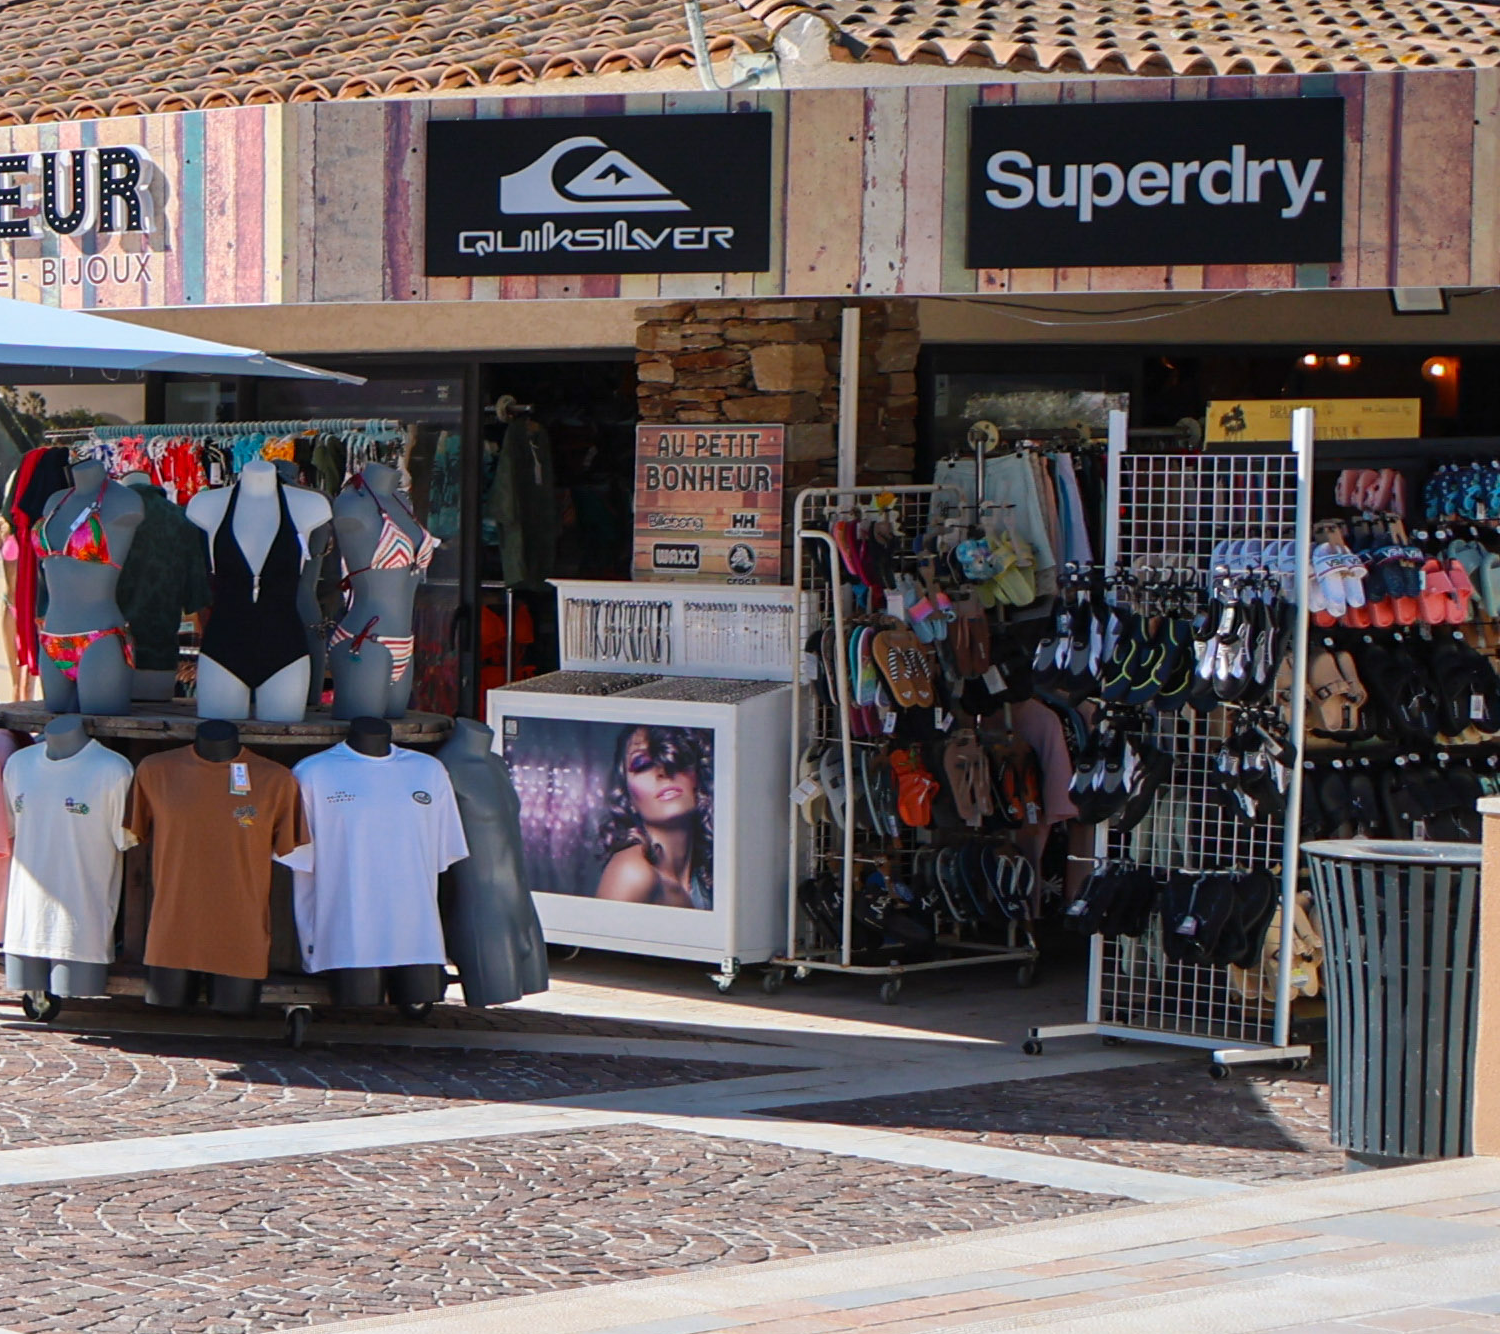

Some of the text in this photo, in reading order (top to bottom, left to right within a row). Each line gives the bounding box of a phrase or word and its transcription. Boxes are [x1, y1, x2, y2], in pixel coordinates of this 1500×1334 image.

[985, 144, 1326, 222] Superdry.
[458, 219, 735, 257] QUIKSILVER
[42, 253, 153, 286] BIJOUX
[658, 433, 760, 458] AU PETIT
[645, 464, 772, 492] BONHEUR
[732, 514, 757, 528] HH
